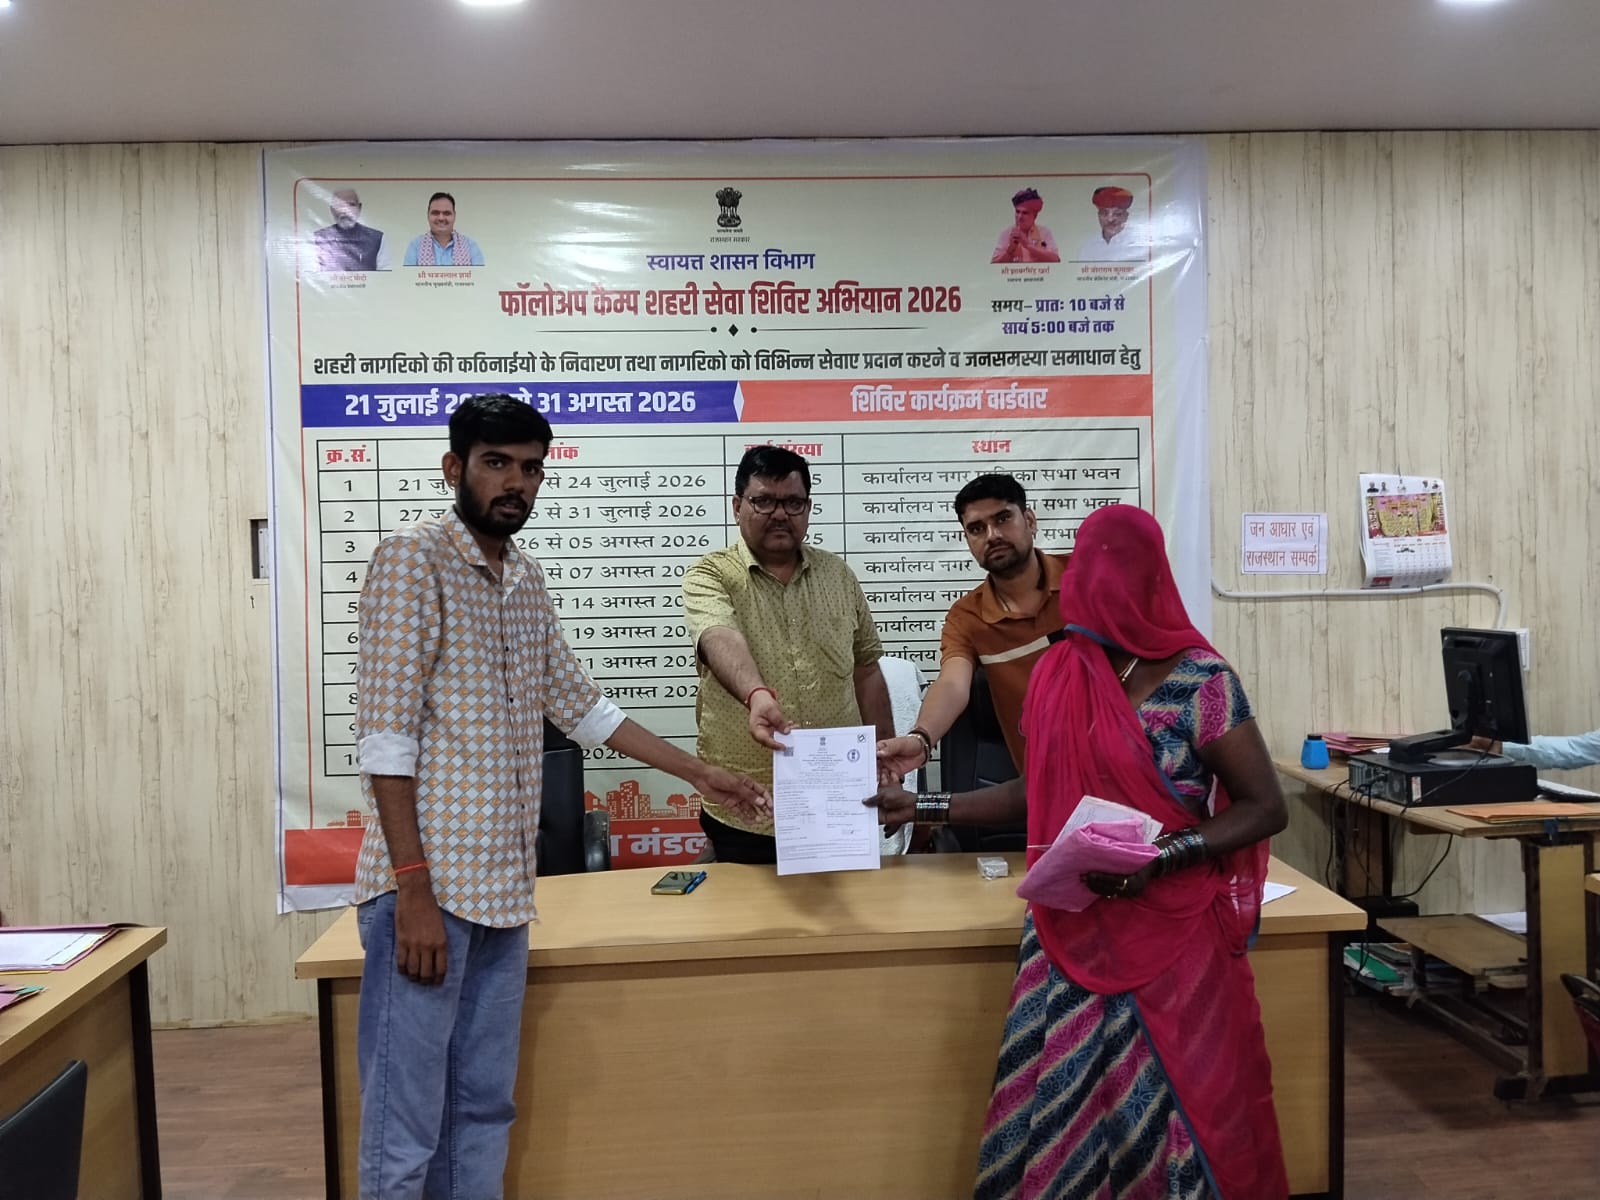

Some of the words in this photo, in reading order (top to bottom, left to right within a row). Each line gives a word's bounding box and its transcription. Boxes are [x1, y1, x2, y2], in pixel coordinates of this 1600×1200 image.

[646, 254, 705, 270] स्वायत्त
[710, 254, 758, 270] शासन
[763, 248, 815, 270] विभाग
[499, 282, 587, 316] फॉलोअप
[592, 282, 640, 316] कैम्प
[645, 282, 698, 315] शहरी
[704, 281, 744, 315] सेवा
[748, 280, 810, 314] शिविर
[817, 279, 901, 313] अभियान
[908, 285, 961, 312] 2026
[1069, 299, 1085, 311] 10
[1089, 295, 1111, 311] बजे
[1114, 294, 1125, 310] से
[1032, 321, 1065, 334] 5:00
[1068, 317, 1090, 333] बजे
[1093, 320, 1115, 333] तक
[314, 353, 355, 374] शहरी
[360, 352, 427, 373] नागरिको
[433, 351, 453, 372] की
[457, 352, 537, 374] कठिनाईयो
[541, 351, 557, 371] के
[560, 352, 621, 373] निवारण
[625, 355, 657, 371] तथा
[660, 350, 726, 371] नागरिको
[730, 350, 751, 370] को
[755, 349, 814, 370] विभिन्न
[863, 352, 902, 369] प्रदान
[907, 347, 946, 368] करने
[950, 353, 959, 368] व
[964, 352, 1047, 369] जनसमस्या
[1051, 350, 1115, 367] समाधान
[1121, 346, 1141, 370] हेतु
[345, 394, 369, 414] 21
[378, 388, 438, 421] जुलाई
[538, 392, 560, 413] 31
[568, 393, 633, 414] अगस्त
[638, 391, 696, 412] 2026
[851, 384, 905, 413] शिविर
[909, 383, 981, 412] कार्यक्रम
[986, 381, 1047, 410] वार्डवार
[971, 439, 1011, 454] स्थान
[546, 475, 561, 489] से
[568, 476, 591, 488] 24
[599, 472, 651, 495] जुलाई
[658, 475, 706, 488] 2026
[862, 468, 933, 484] कार्यालय
[937, 470, 970, 483] नगर
[1041, 469, 1077, 481] सभा
[1083, 468, 1121, 481] भवन
[343, 480, 352, 492] 1
[398, 479, 421, 491] 21
[544, 503, 562, 519] से
[569, 507, 591, 518] 31
[598, 501, 652, 523] जुलाई
[658, 505, 706, 517] 2026
[863, 497, 933, 514] कार्यालय
[1042, 498, 1077, 511] सभा
[344, 511, 354, 522] 2
[400, 510, 423, 522] 27
[864, 527, 934, 544] कार्यालय
[1250, 522, 1265, 537] जन
[345, 541, 355, 553] 3
[517, 538, 539, 550] 26
[545, 533, 562, 550] से
[569, 537, 592, 549] 05
[600, 536, 655, 548] अगस्त
[661, 535, 709, 547] 2026
[864, 556, 935, 573] कार्यालय
[939, 560, 973, 571] नगर
[1246, 551, 1285, 566] राजस्थान
[346, 571, 358, 584] 4
[546, 563, 562, 580] से
[570, 567, 593, 579] 07
[601, 566, 656, 579] अगस्त
[662, 565, 686, 577] 20
[864, 586, 936, 603] कार्यालय
[348, 602, 358, 613] 5
[572, 597, 594, 609] 14
[601, 596, 656, 609] अगस्त
[348, 632, 358, 643] 6
[573, 628, 595, 639] 19
[601, 627, 656, 639] अगस्त
[663, 625, 690, 638] 20
[602, 657, 657, 669] अगस्त
[664, 656, 696, 668] 202
[603, 687, 658, 698] अगस्त
[664, 686, 698, 698] 202
